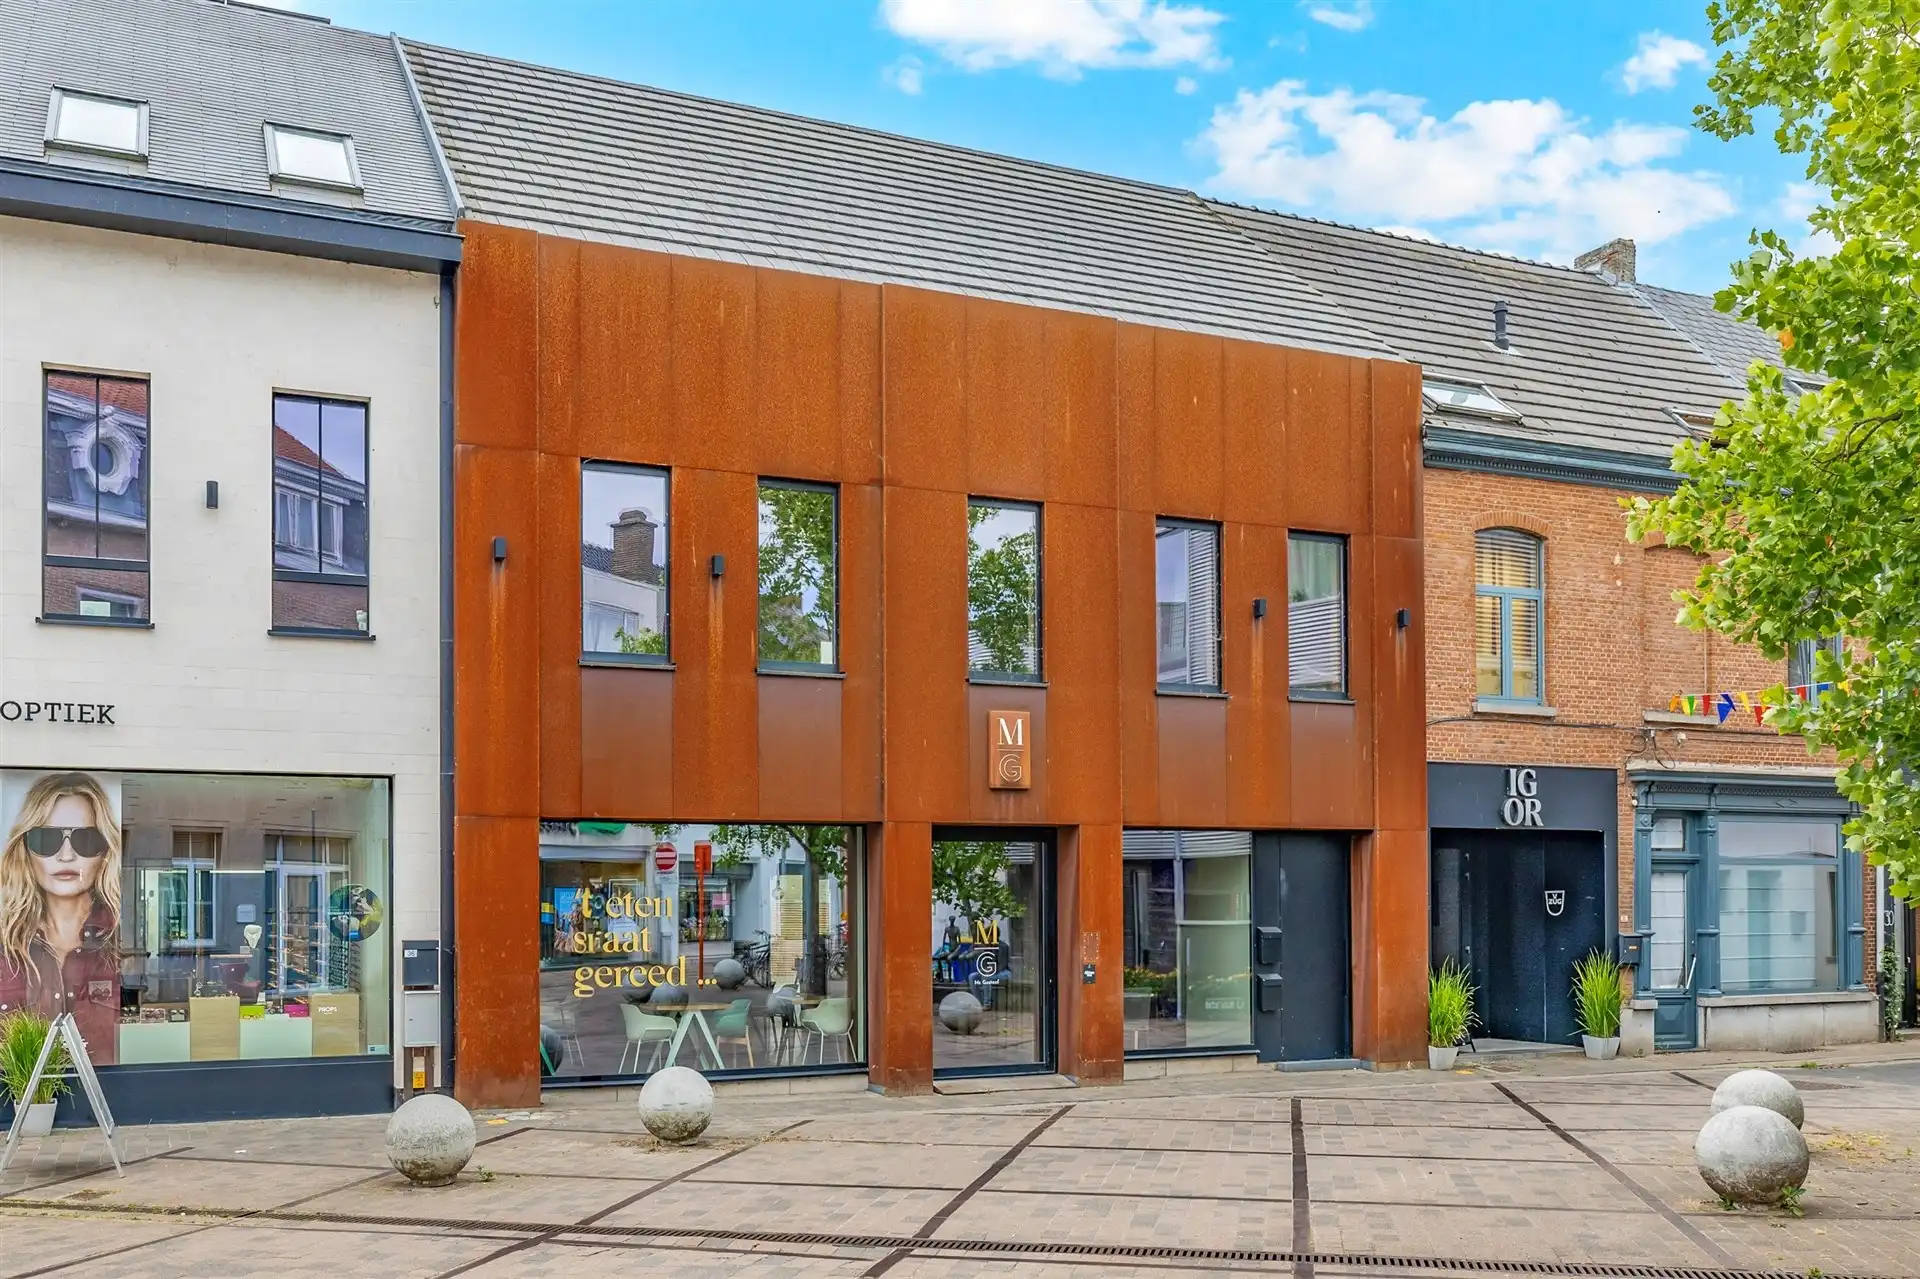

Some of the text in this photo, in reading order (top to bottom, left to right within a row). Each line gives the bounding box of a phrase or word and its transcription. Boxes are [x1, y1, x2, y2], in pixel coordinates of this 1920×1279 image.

[0, 700, 115, 725] OPTIEK
[996, 717, 1025, 746] M
[998, 753, 1023, 782] G
[1507, 768, 1538, 797] IG
[1503, 797, 1545, 826] OR
[605, 891, 673, 919] eten
[974, 919, 999, 945] M
[573, 955, 688, 998] gereed
[976, 951, 997, 977] G
